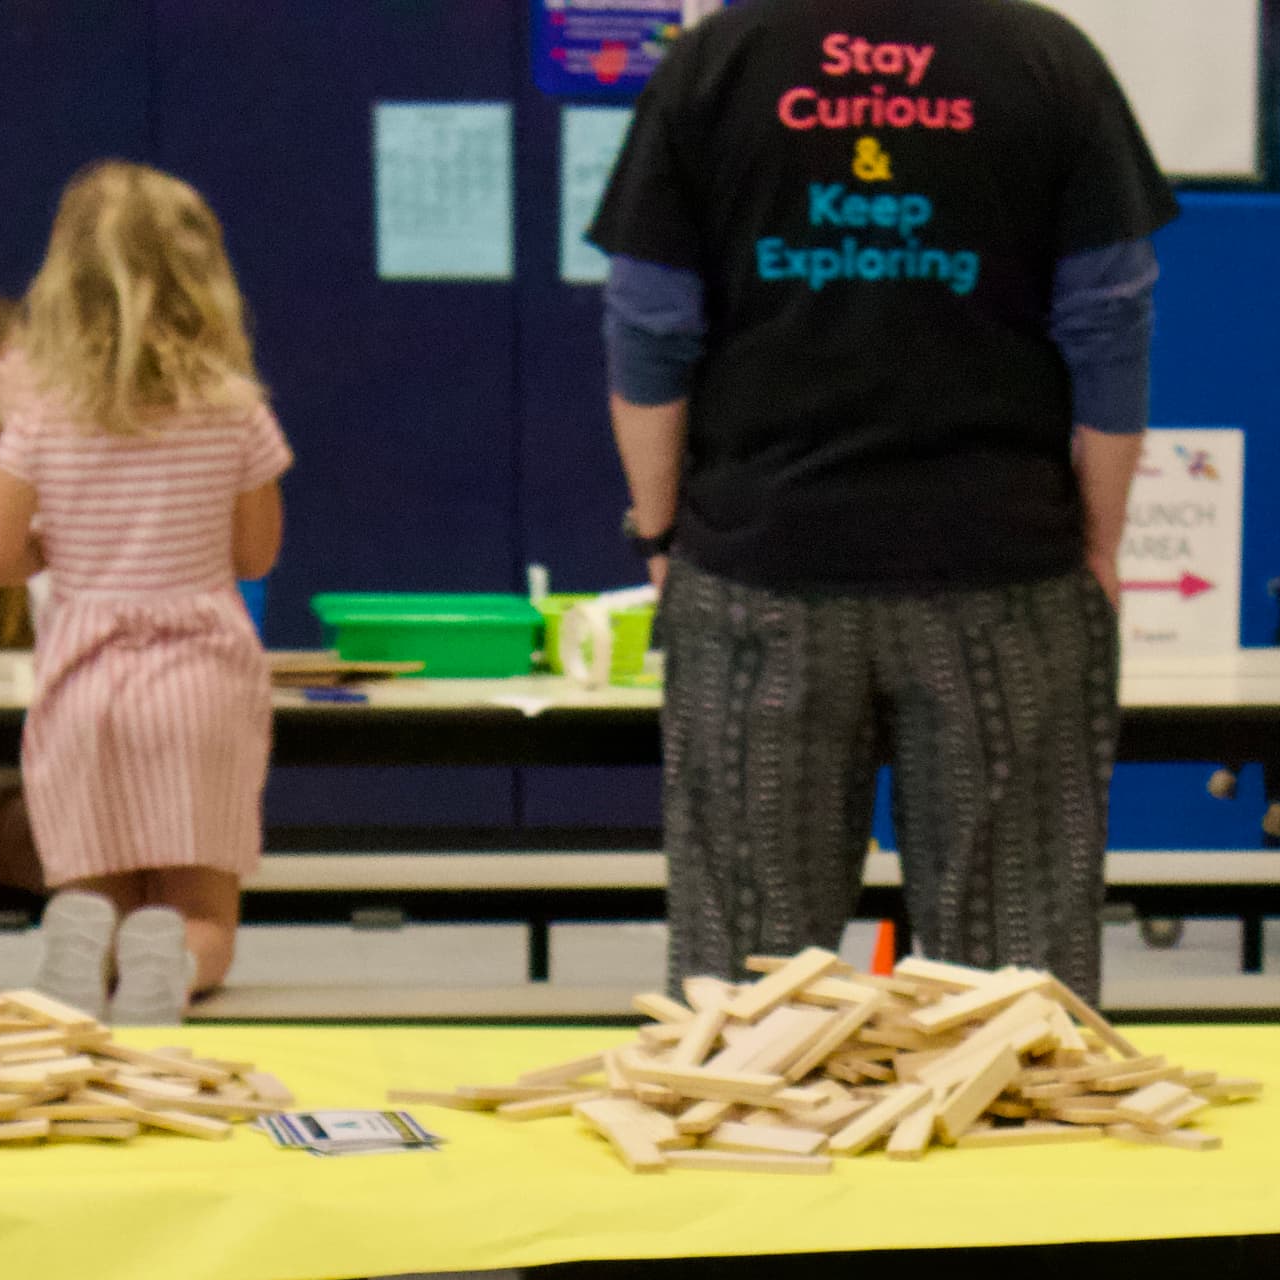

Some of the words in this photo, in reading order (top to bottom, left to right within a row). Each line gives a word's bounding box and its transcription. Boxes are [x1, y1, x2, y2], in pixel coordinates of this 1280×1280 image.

[821, 32, 934, 86] Stay
[777, 86, 974, 132] Curious
[851, 137, 892, 181] &
[808, 182, 931, 238] Keep
[756, 238, 979, 294] Exploring
[1128, 502, 1216, 527] UNCH
